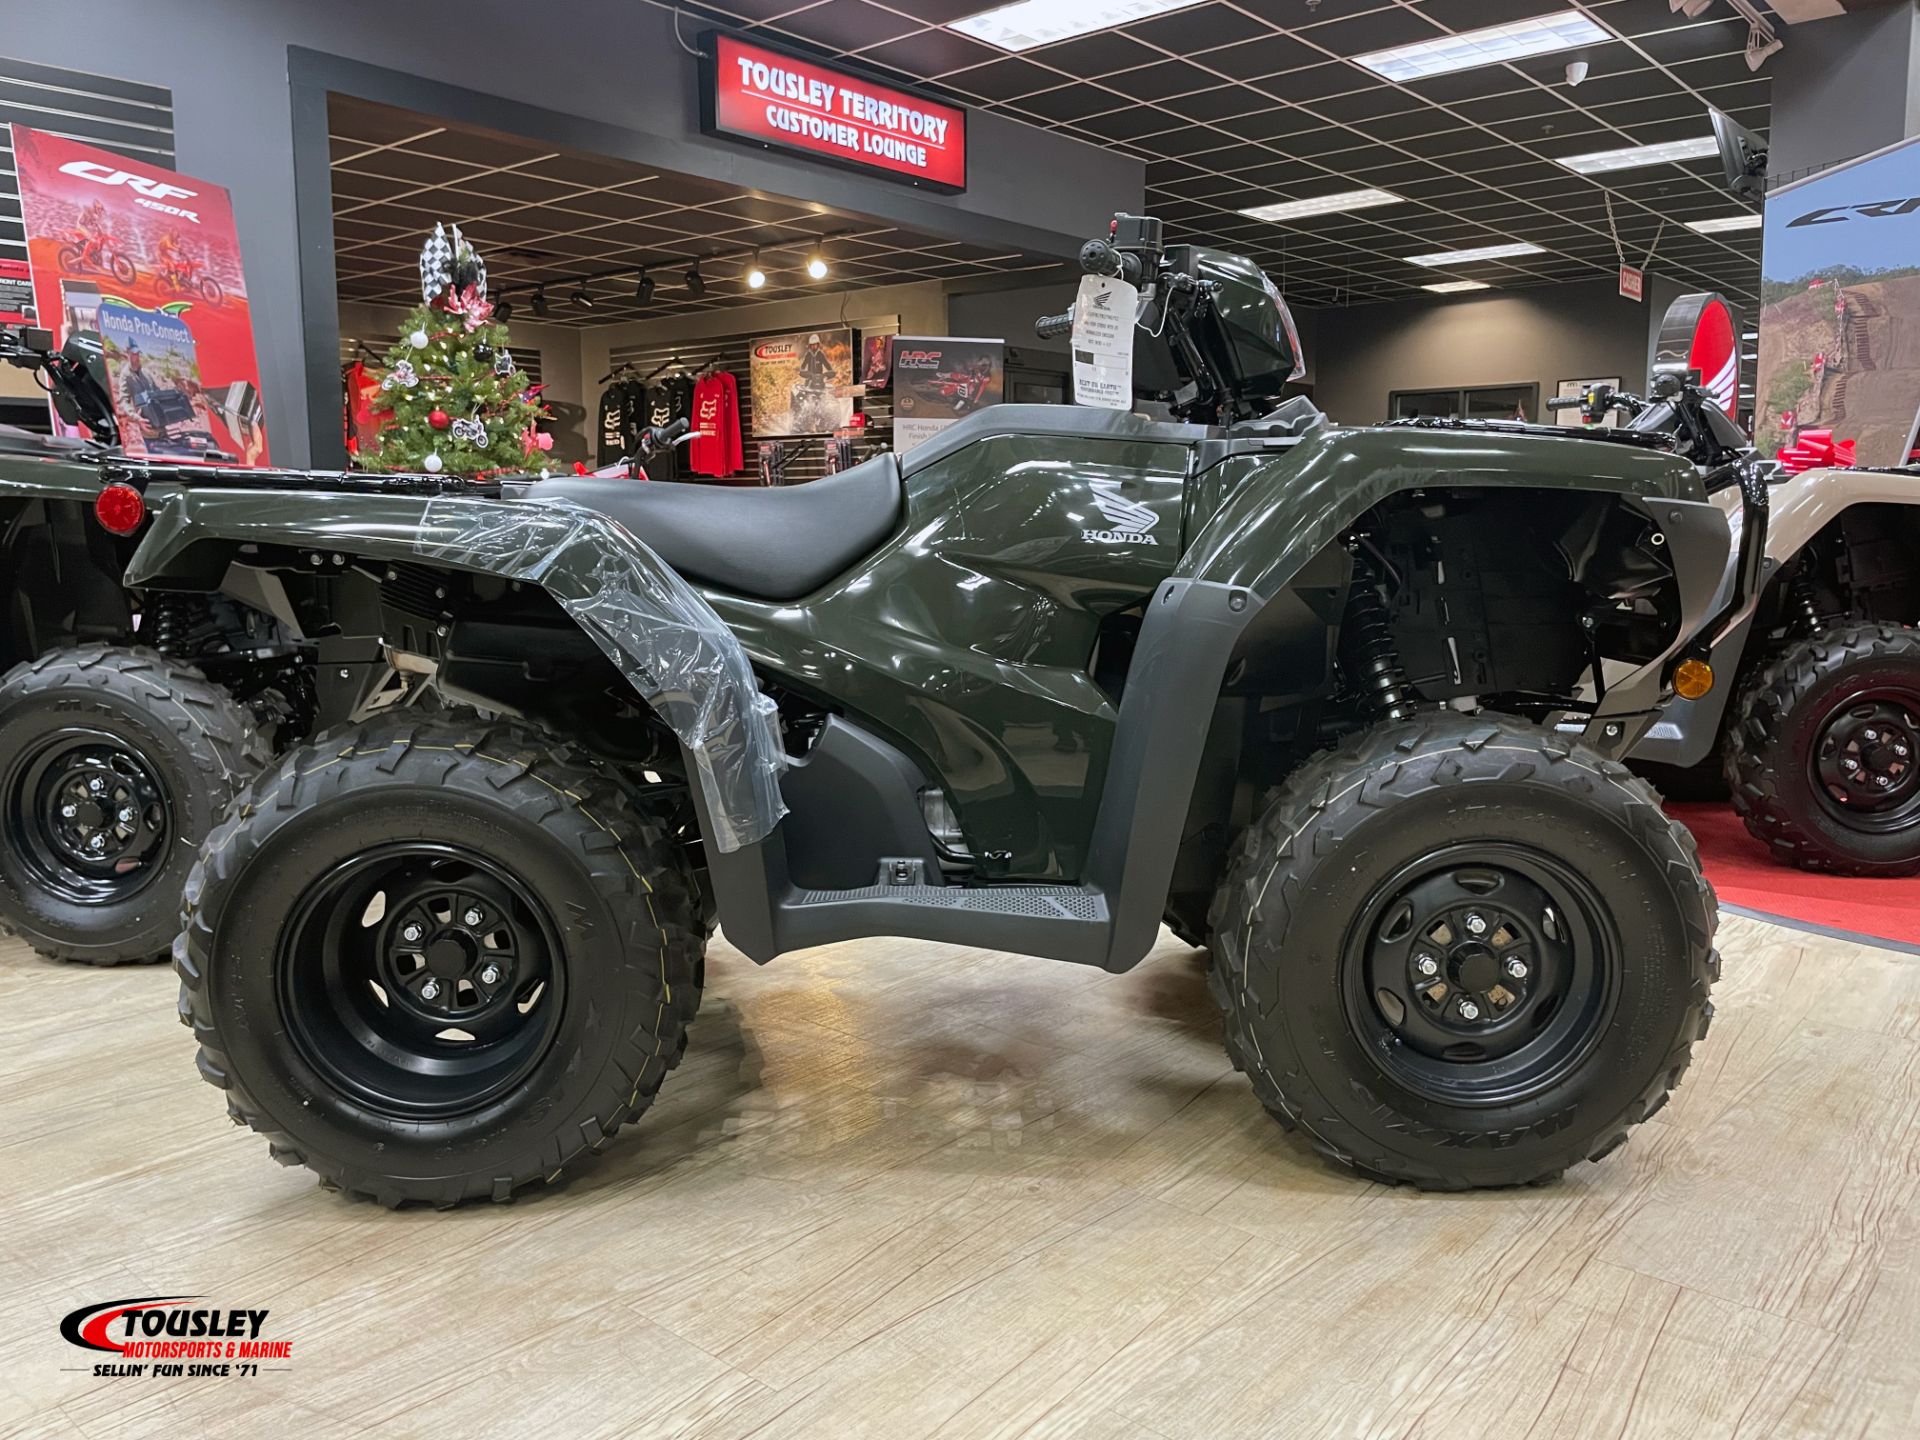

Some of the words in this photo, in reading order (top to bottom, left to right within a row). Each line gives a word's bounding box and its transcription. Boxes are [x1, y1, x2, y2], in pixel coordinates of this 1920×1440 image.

[738, 57, 835, 111] TOUSLEY
[840, 89, 949, 145] TERRITORY
[766, 105, 860, 152] CUSTOMER
[863, 132, 927, 167] LOUNGE
[58, 161, 199, 199] CRF
[134, 198, 201, 224] 450R
[102, 310, 134, 332] Honda
[133, 317, 190, 343] Pro-Connect
[899, 350, 942, 367] HRC
[1081, 529, 1159, 546] HONDA
